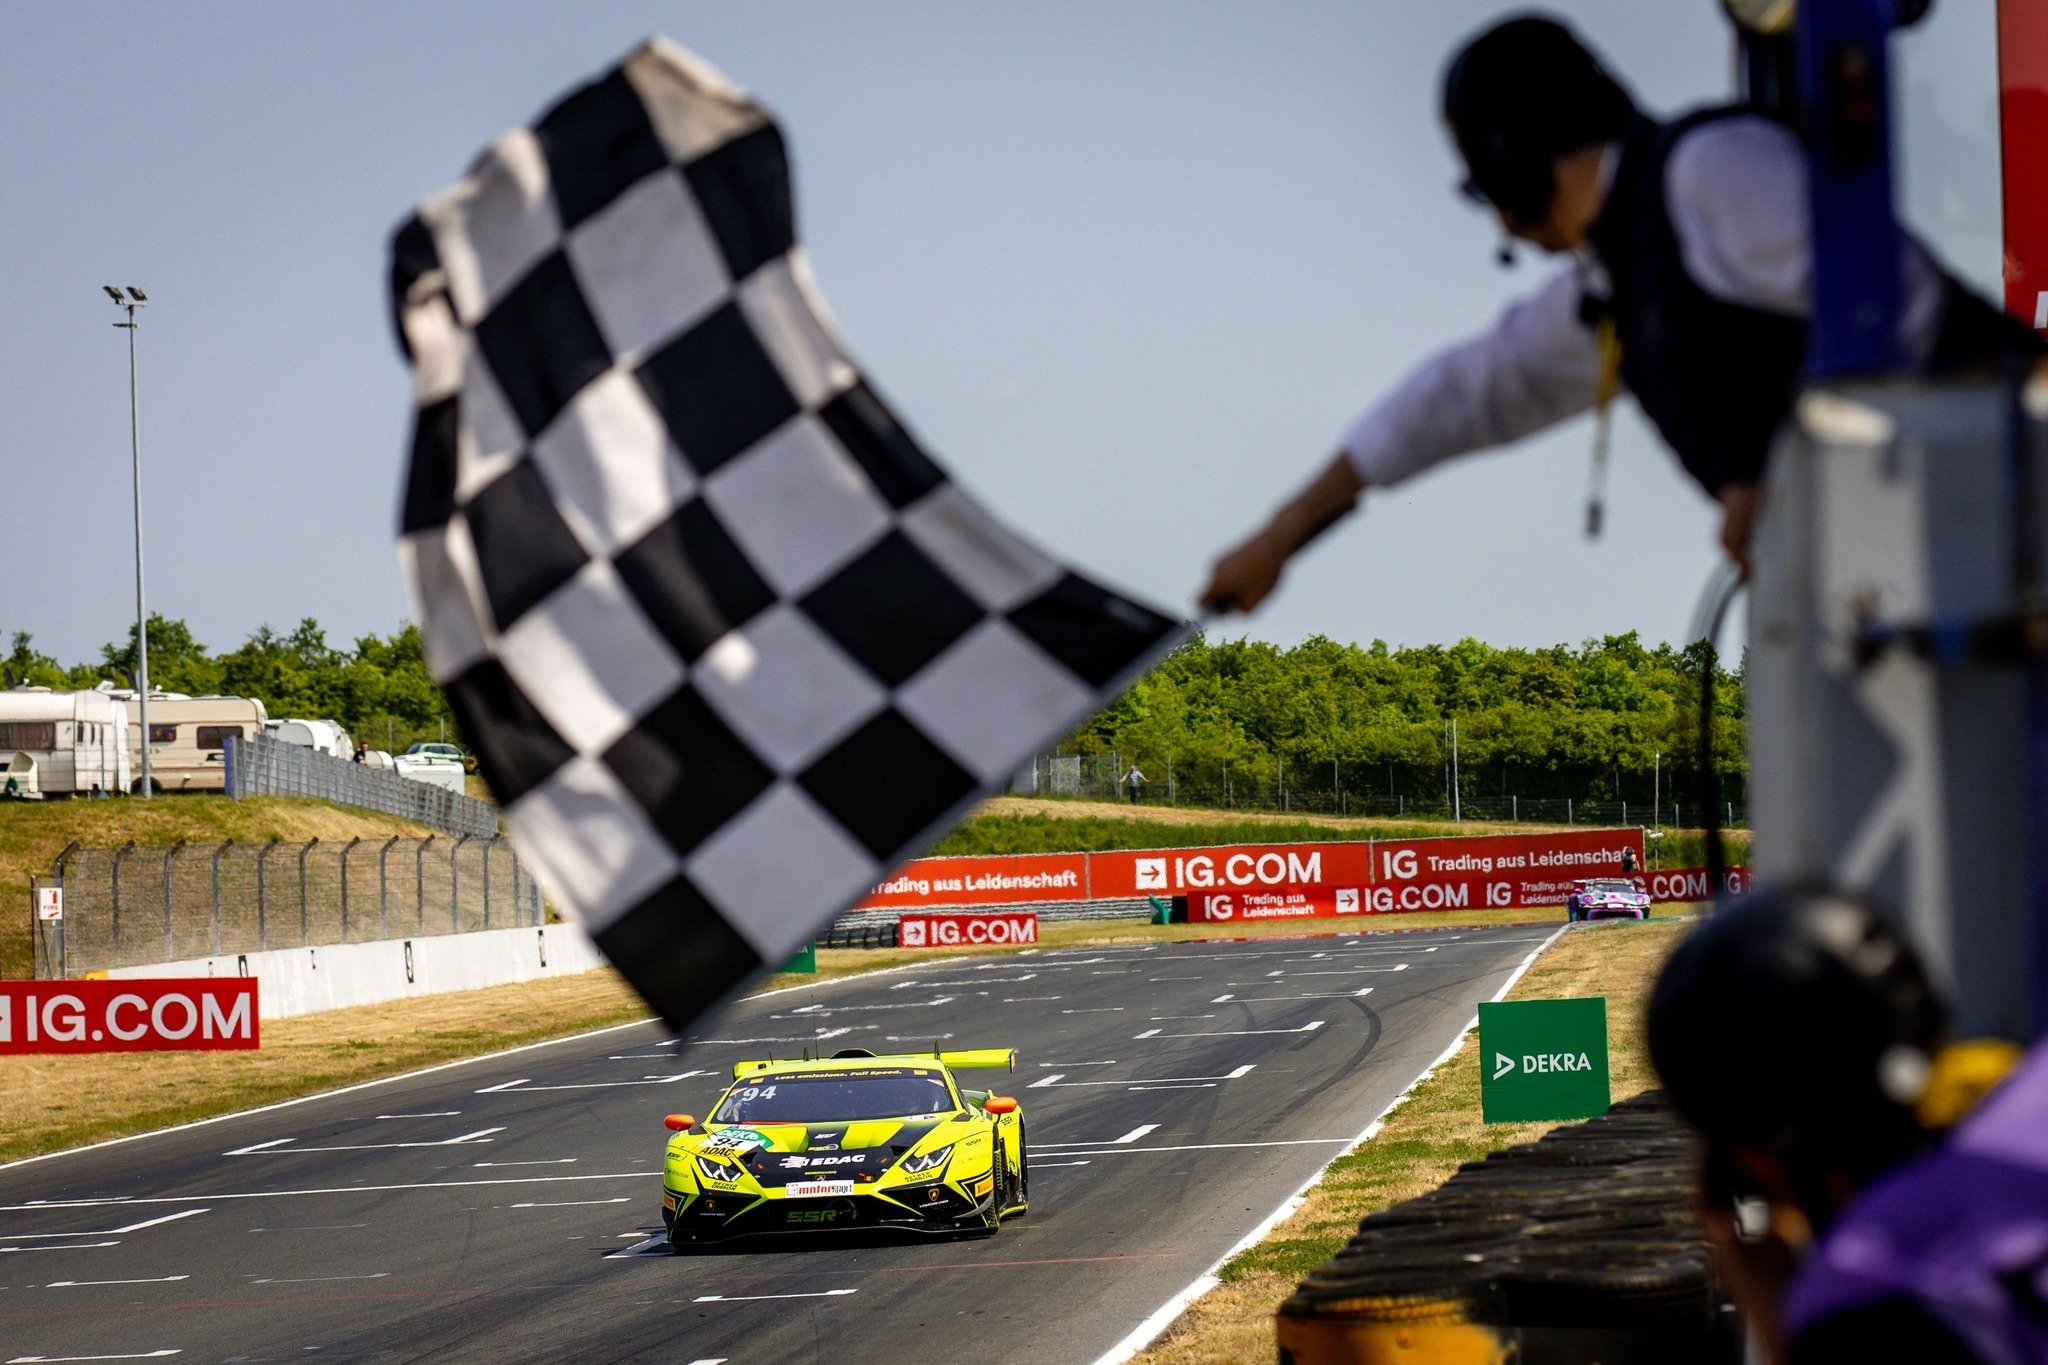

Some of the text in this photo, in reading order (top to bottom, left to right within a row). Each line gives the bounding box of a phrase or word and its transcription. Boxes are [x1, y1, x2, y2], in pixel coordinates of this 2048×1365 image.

[1174, 851, 1322, 888] IG.COM
[1383, 850, 1418, 880] IG
[1427, 854, 1493, 873] Trading
[1497, 855, 1526, 868] aus
[933, 878, 963, 892] aus
[965, 869, 1078, 891] Leidenschaft
[1520, 881, 1556, 893] Trading
[1242, 893, 1306, 906] Trading aus
[1364, 882, 1469, 912] IG.COM
[1486, 881, 1512, 906] IG
[1520, 893, 1569, 905] Leidensch
[1204, 894, 1234, 920] IG
[1243, 905, 1315, 918] Leidenschaft
[930, 918, 1036, 944] IG.COM
[26, 991, 253, 1043] IG.COM
[1522, 1052, 1592, 1074] DEKRA
[741, 1085, 777, 1101] 94
[699, 1146, 736, 1157] ADAC
[714, 1137, 744, 1148] 94
[810, 1154, 867, 1167] EDAG
[786, 1209, 838, 1223] SSR
